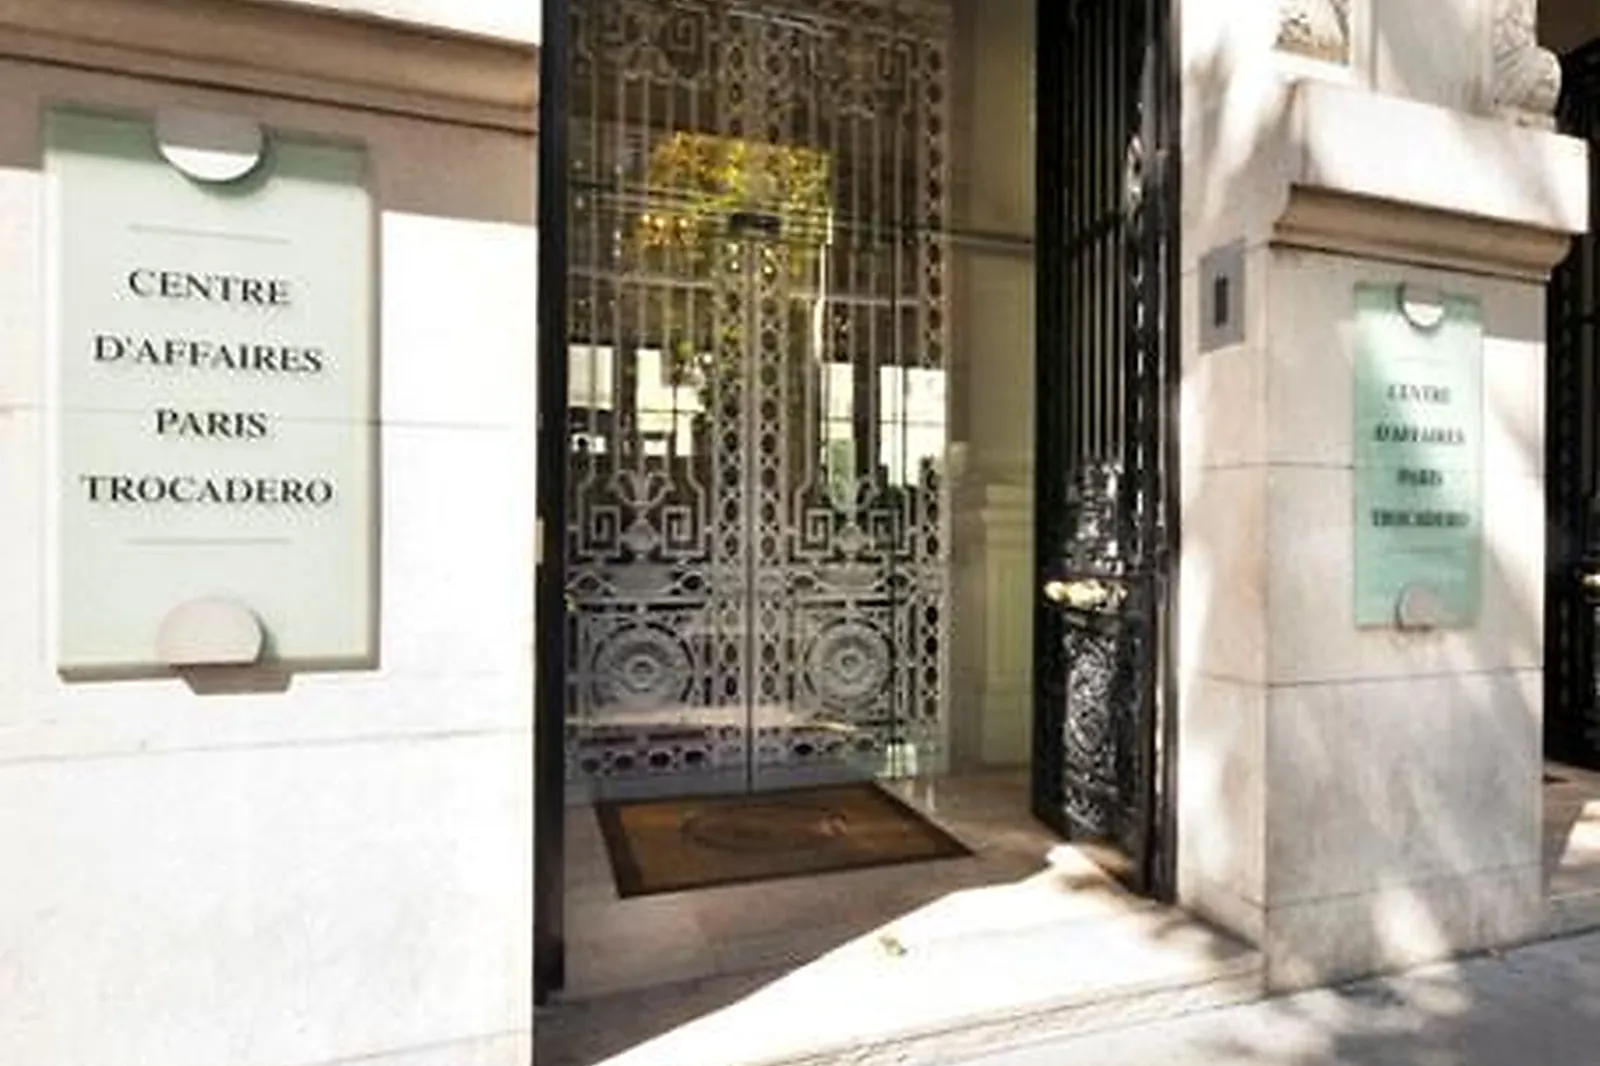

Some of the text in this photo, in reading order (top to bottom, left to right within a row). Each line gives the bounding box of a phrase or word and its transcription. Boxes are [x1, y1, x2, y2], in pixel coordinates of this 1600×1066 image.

[127, 269, 292, 306] CENTRE
[93, 334, 323, 373] D'AFFAIRES
[154, 408, 268, 438] PARIS
[80, 474, 334, 506] TROCADERO
